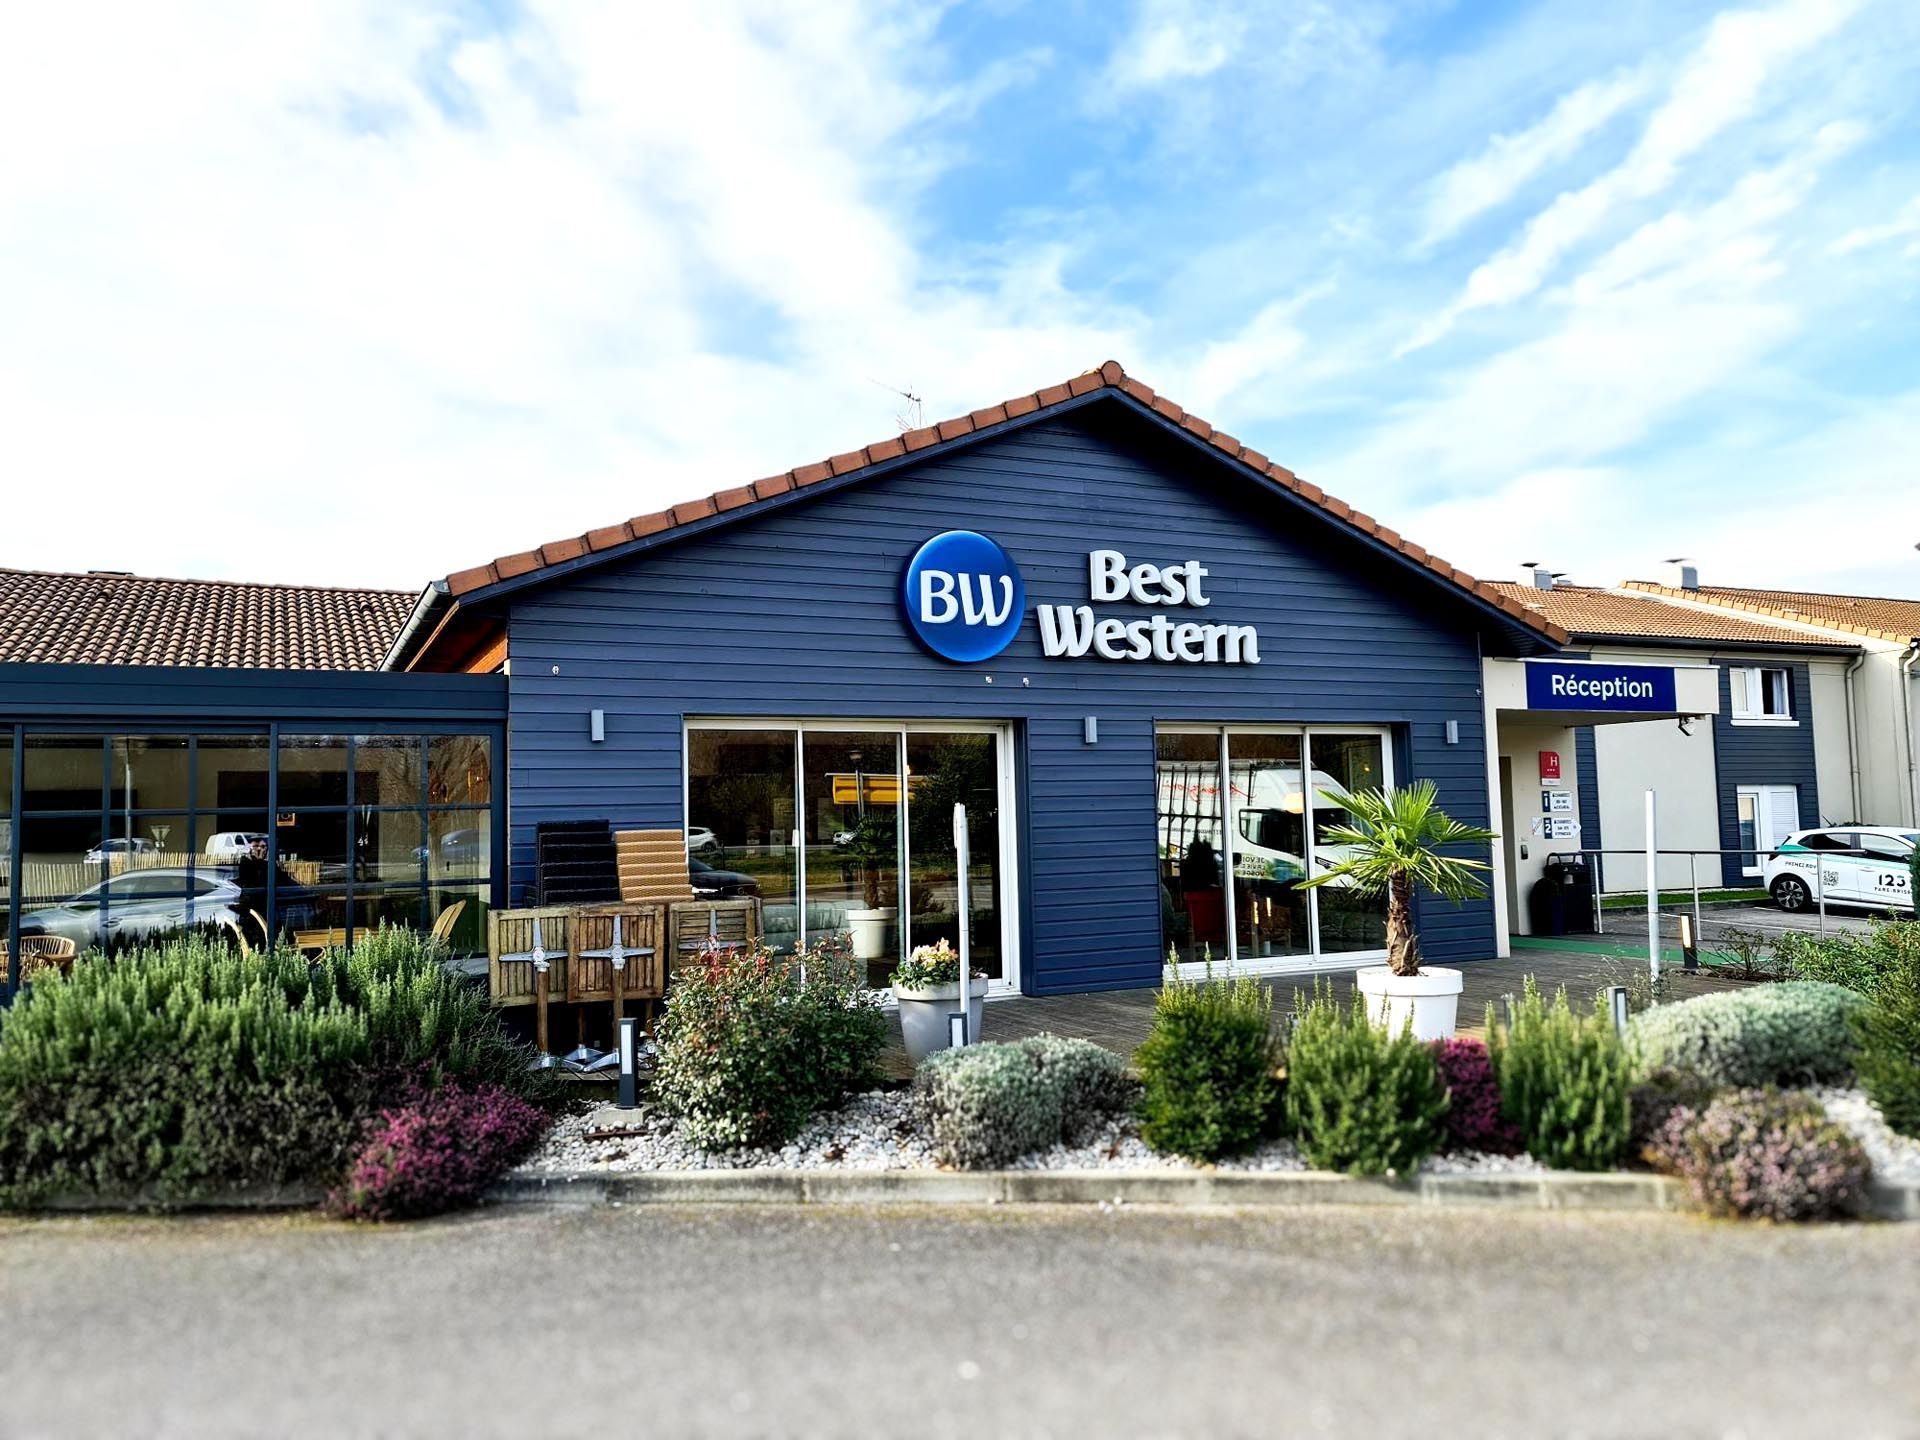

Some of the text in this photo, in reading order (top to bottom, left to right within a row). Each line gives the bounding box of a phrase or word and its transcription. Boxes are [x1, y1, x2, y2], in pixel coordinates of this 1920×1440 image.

[1089, 549, 1211, 608] Best
[920, 570, 1014, 627] BW
[1036, 604, 1261, 665] Western
[1551, 673, 1654, 701] Réception
[1550, 756, 1558, 767] H
[1545, 823, 1552, 834] 2
[1878, 873, 1906, 888] 123
